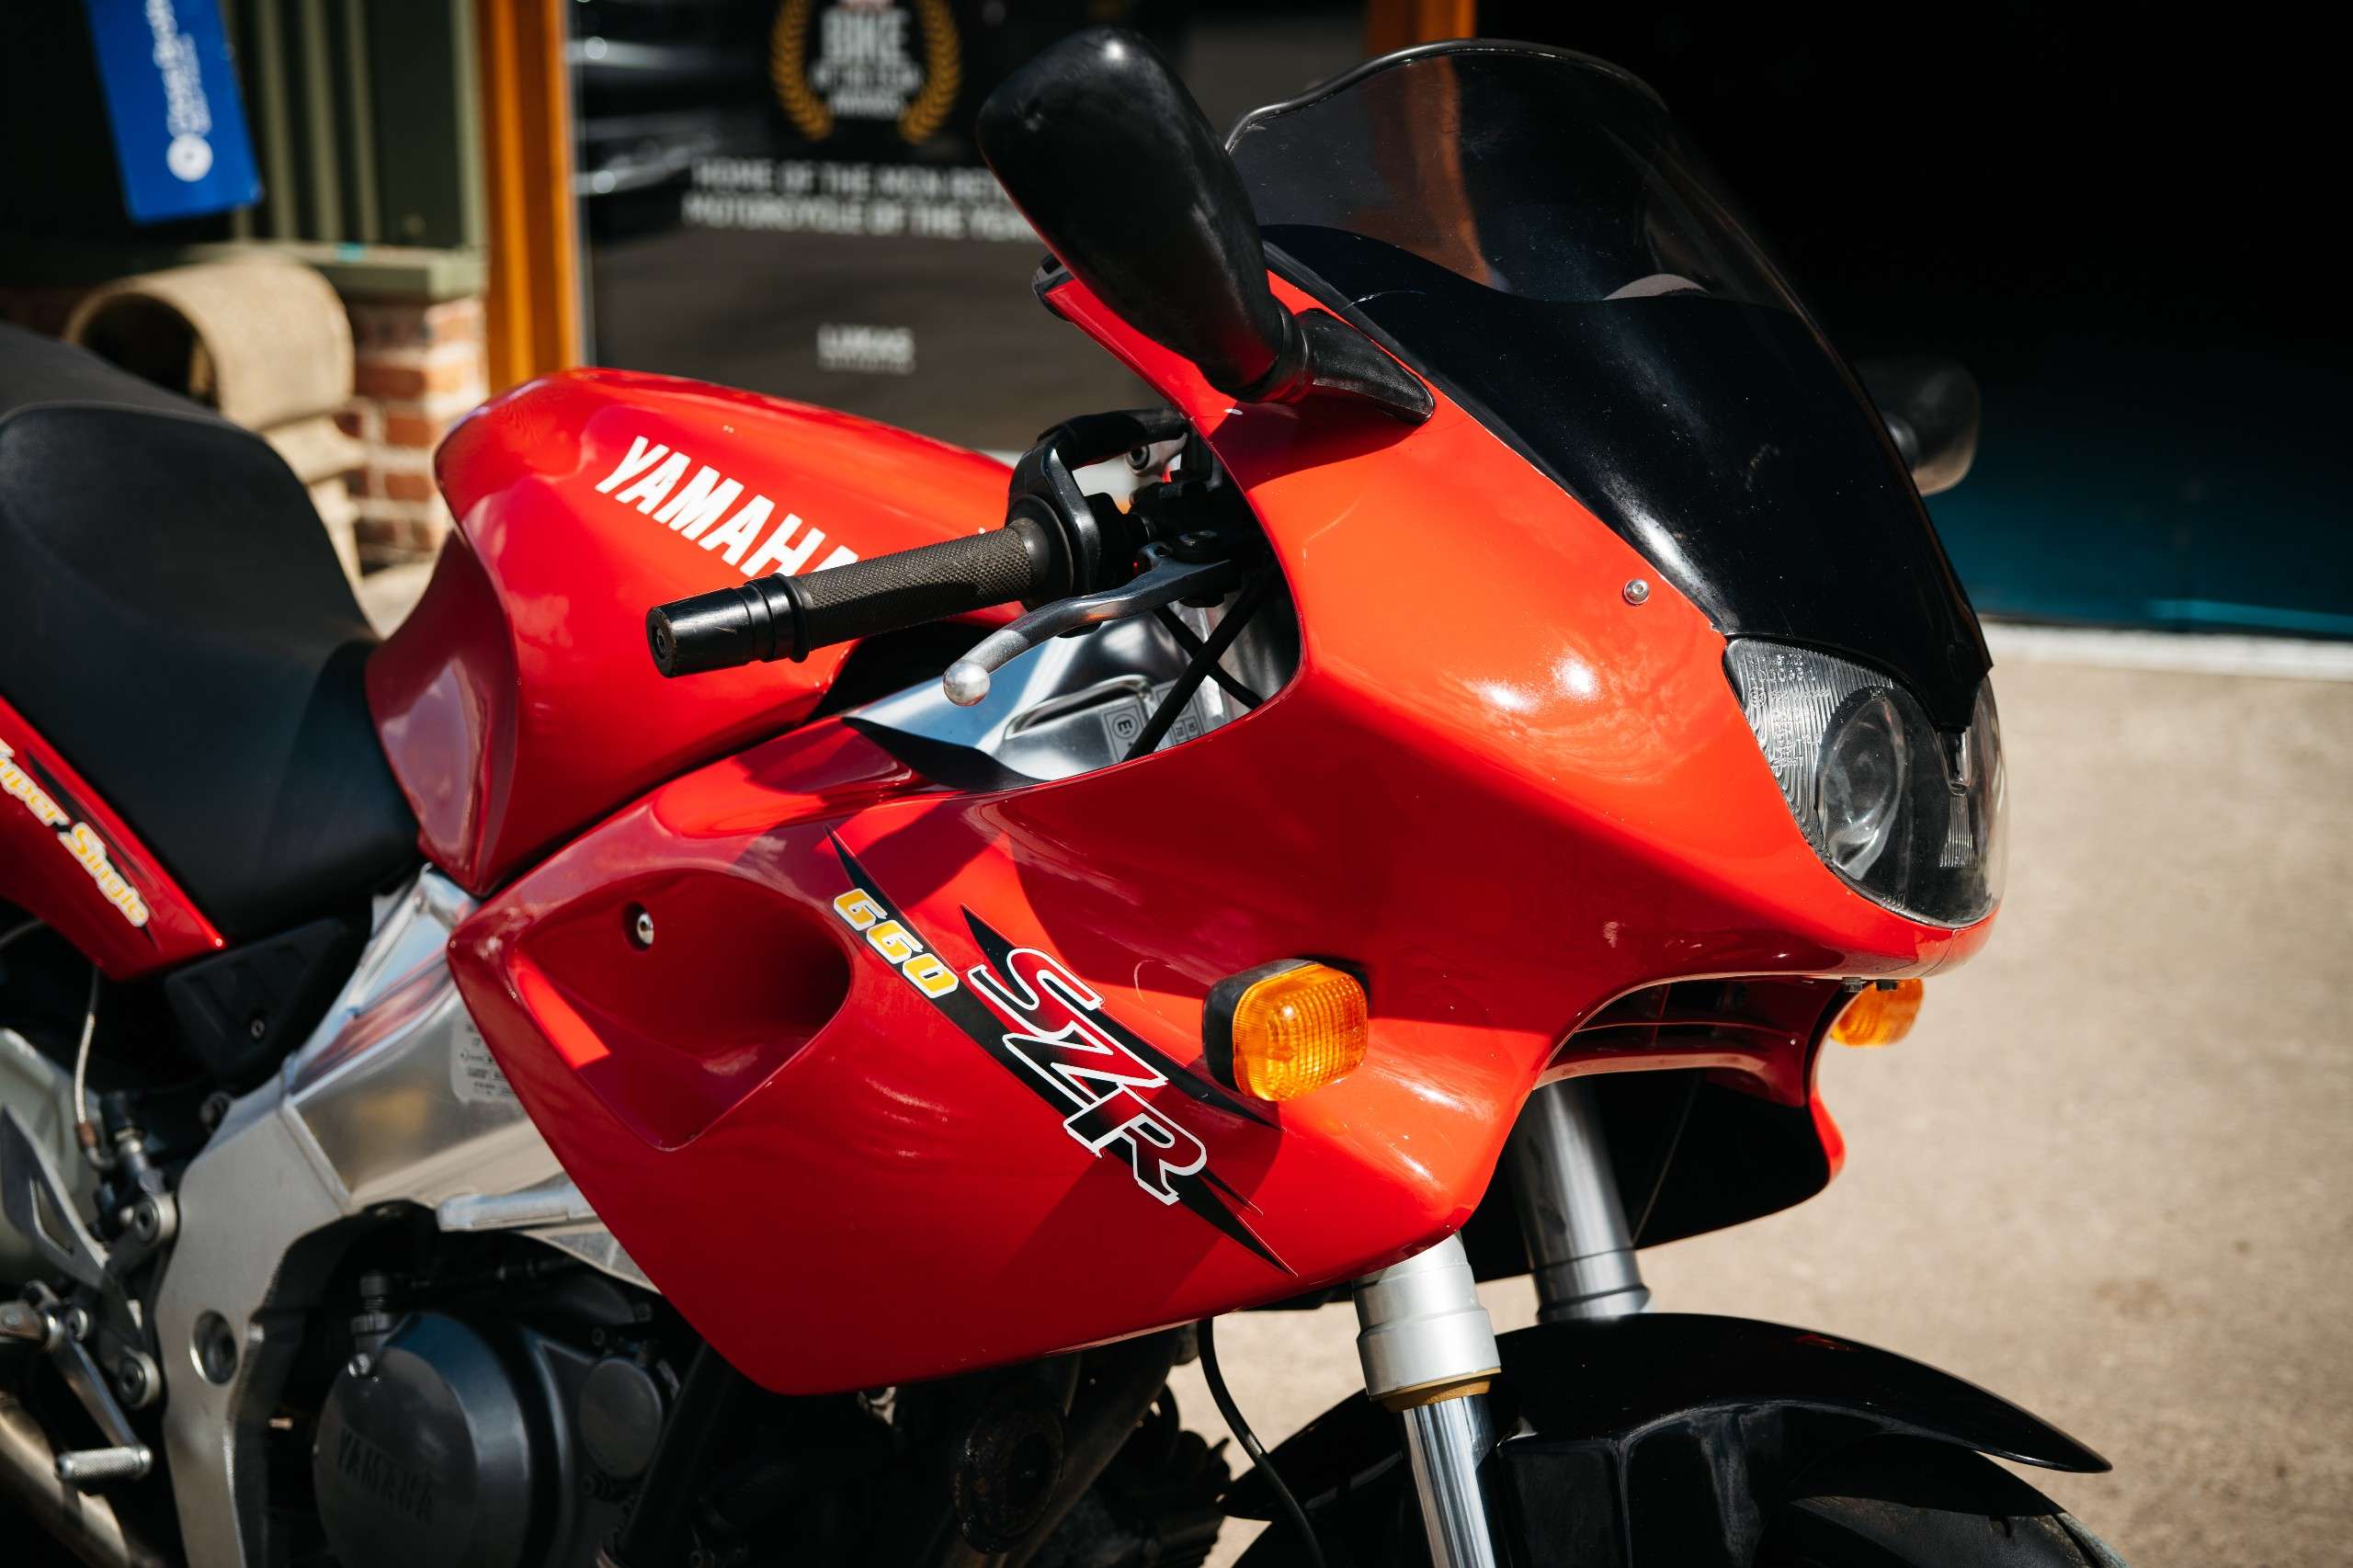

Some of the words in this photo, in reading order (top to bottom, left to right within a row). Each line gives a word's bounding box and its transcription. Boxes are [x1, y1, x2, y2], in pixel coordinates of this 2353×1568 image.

[681, 192, 864, 233] MOTORCYCLE
[868, 199, 905, 236] OF
[911, 199, 965, 239] THE
[691, 158, 772, 190] HOME
[778, 161, 814, 192] OF
[819, 163, 870, 194] THE
[0, 738, 70, 826] uper
[57, 822, 149, 927] Single
[834, 888, 960, 998] 660
[968, 948, 1208, 1206] SZR
